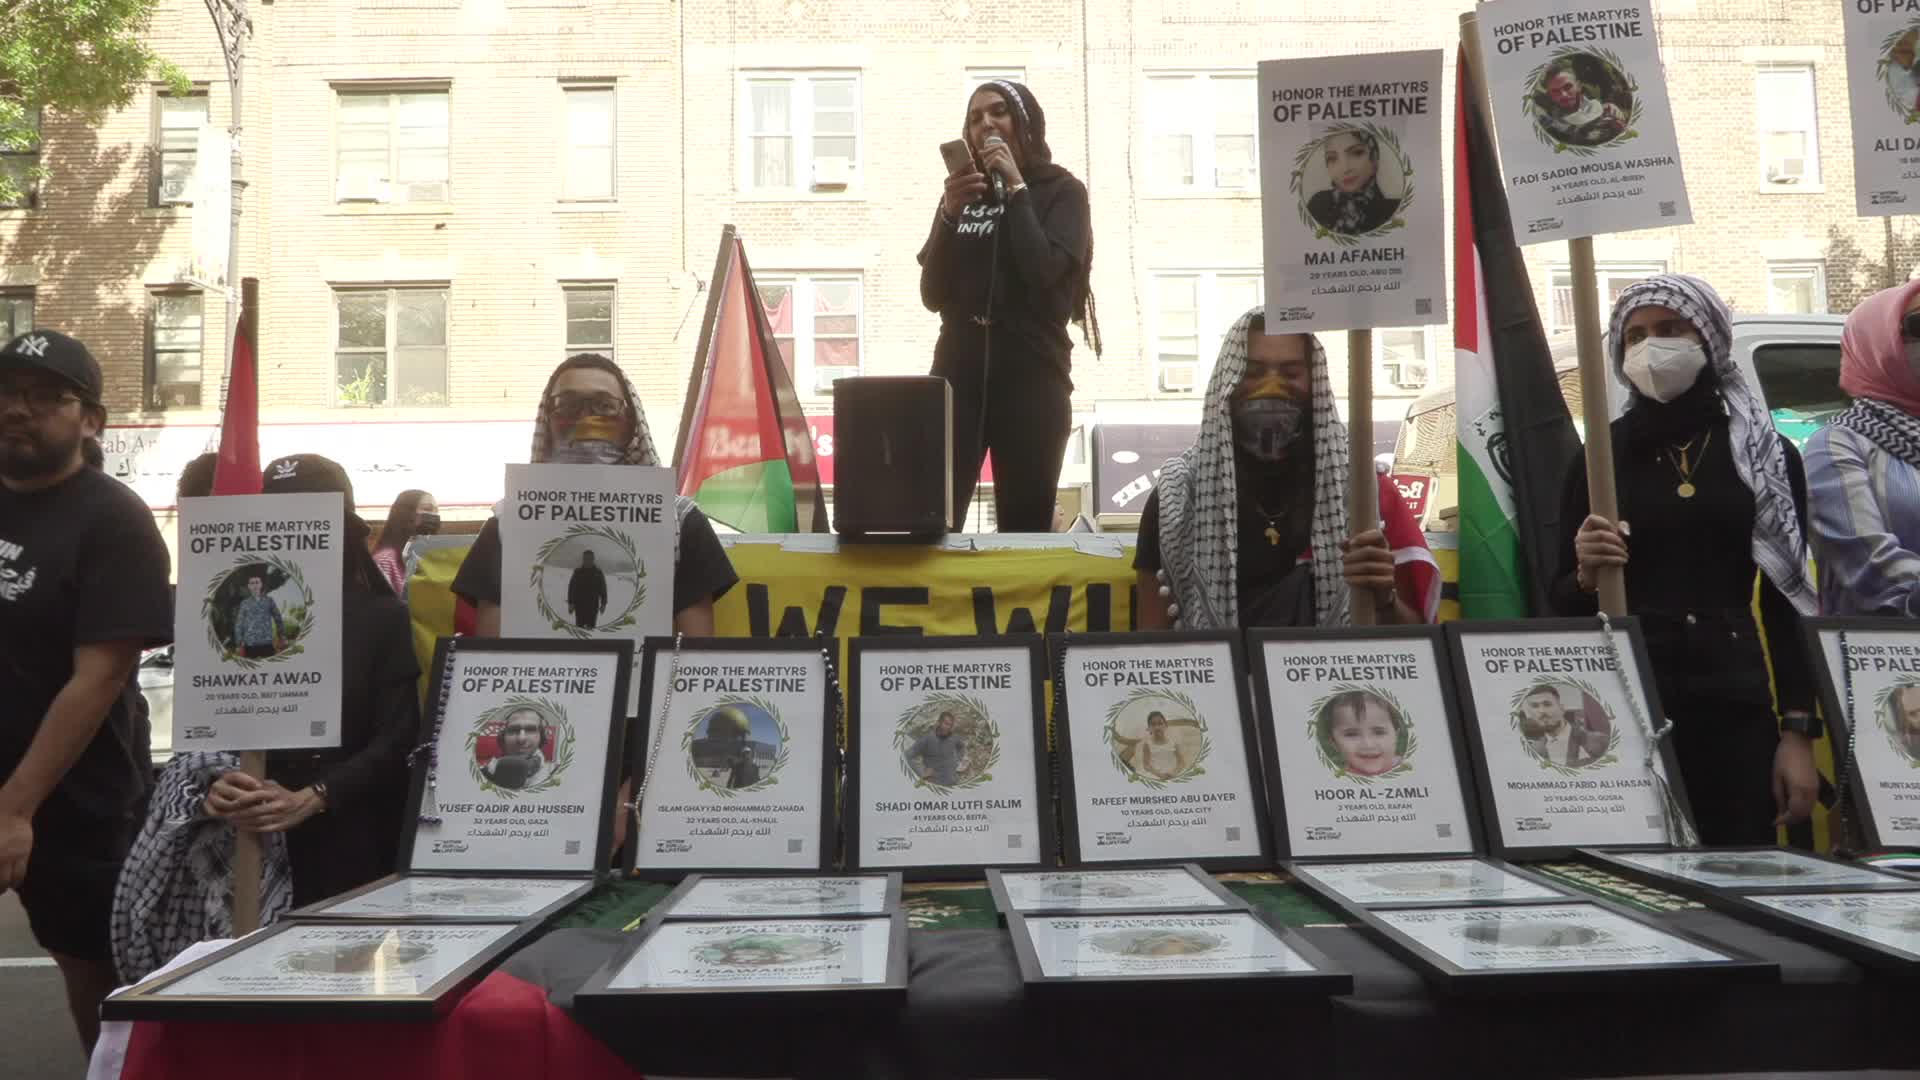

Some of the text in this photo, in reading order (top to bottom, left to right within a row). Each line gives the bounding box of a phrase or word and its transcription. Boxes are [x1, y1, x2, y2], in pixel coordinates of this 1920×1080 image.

[1857, 0, 1885, 13] OF
[1494, 8, 1639, 36] HONOR THE MARTYRS
[1497, 22, 1642, 55] OF PALESTINE
[1273, 81, 1429, 101] HONOR THE MARTYRS
[1273, 97, 1428, 122] OF PALESTINE
[1875, 139, 1899, 151] ALI
[1513, 156, 1674, 186] FADI SADIQ MOUSA WASHHA
[1562, 181, 1589, 190] YEARS
[1305, 248, 1404, 265] MAI AFANEH
[1322, 271, 1347, 279] YEARS
[518, 491, 663, 504] HONOR THE MARTYRS
[518, 504, 661, 523] OF PALESTINE
[190, 520, 330, 534] HONOR THE MARTYRS
[191, 534, 329, 553] OF PALESTINE
[972, 583, 1137, 637] WI
[1481, 646, 1613, 657] HONOR THE MARTYRS
[1849, 646, 1912, 656] ONOR THE
[1082, 658, 1213, 670] HONOR THE MARTYRS
[1283, 654, 1416, 665] HONOR THE MARTYRS
[1486, 658, 1616, 673] OF PALESTINE
[1848, 658, 1870, 672] OF
[464, 666, 598, 677] HONOR THE MARTYRS
[676, 667, 807, 676] HONOR THE MARTYRS
[880, 663, 1011, 675] HONOR THE MARTYRS
[1287, 666, 1418, 682] OF PALESTINE
[193, 672, 321, 687] SHAWKAT AWAD
[674, 678, 805, 692] OF PALESTINE
[880, 675, 1011, 691] OF PALESTINE
[1085, 670, 1215, 687] OF PALESTINE
[463, 679, 596, 693] OF PALESTINE
[1507, 782, 1567, 790] MOHAMMAD
[1092, 793, 1235, 806] RAFEEF MURSHED ABU DAYER
[1315, 787, 1429, 800] HOOR AL-ZAMLI
[439, 804, 584, 813] YUSEF QADIR ABU HUSSEIN
[876, 800, 1021, 812] SHADI OMAR LUTFI SALIM
